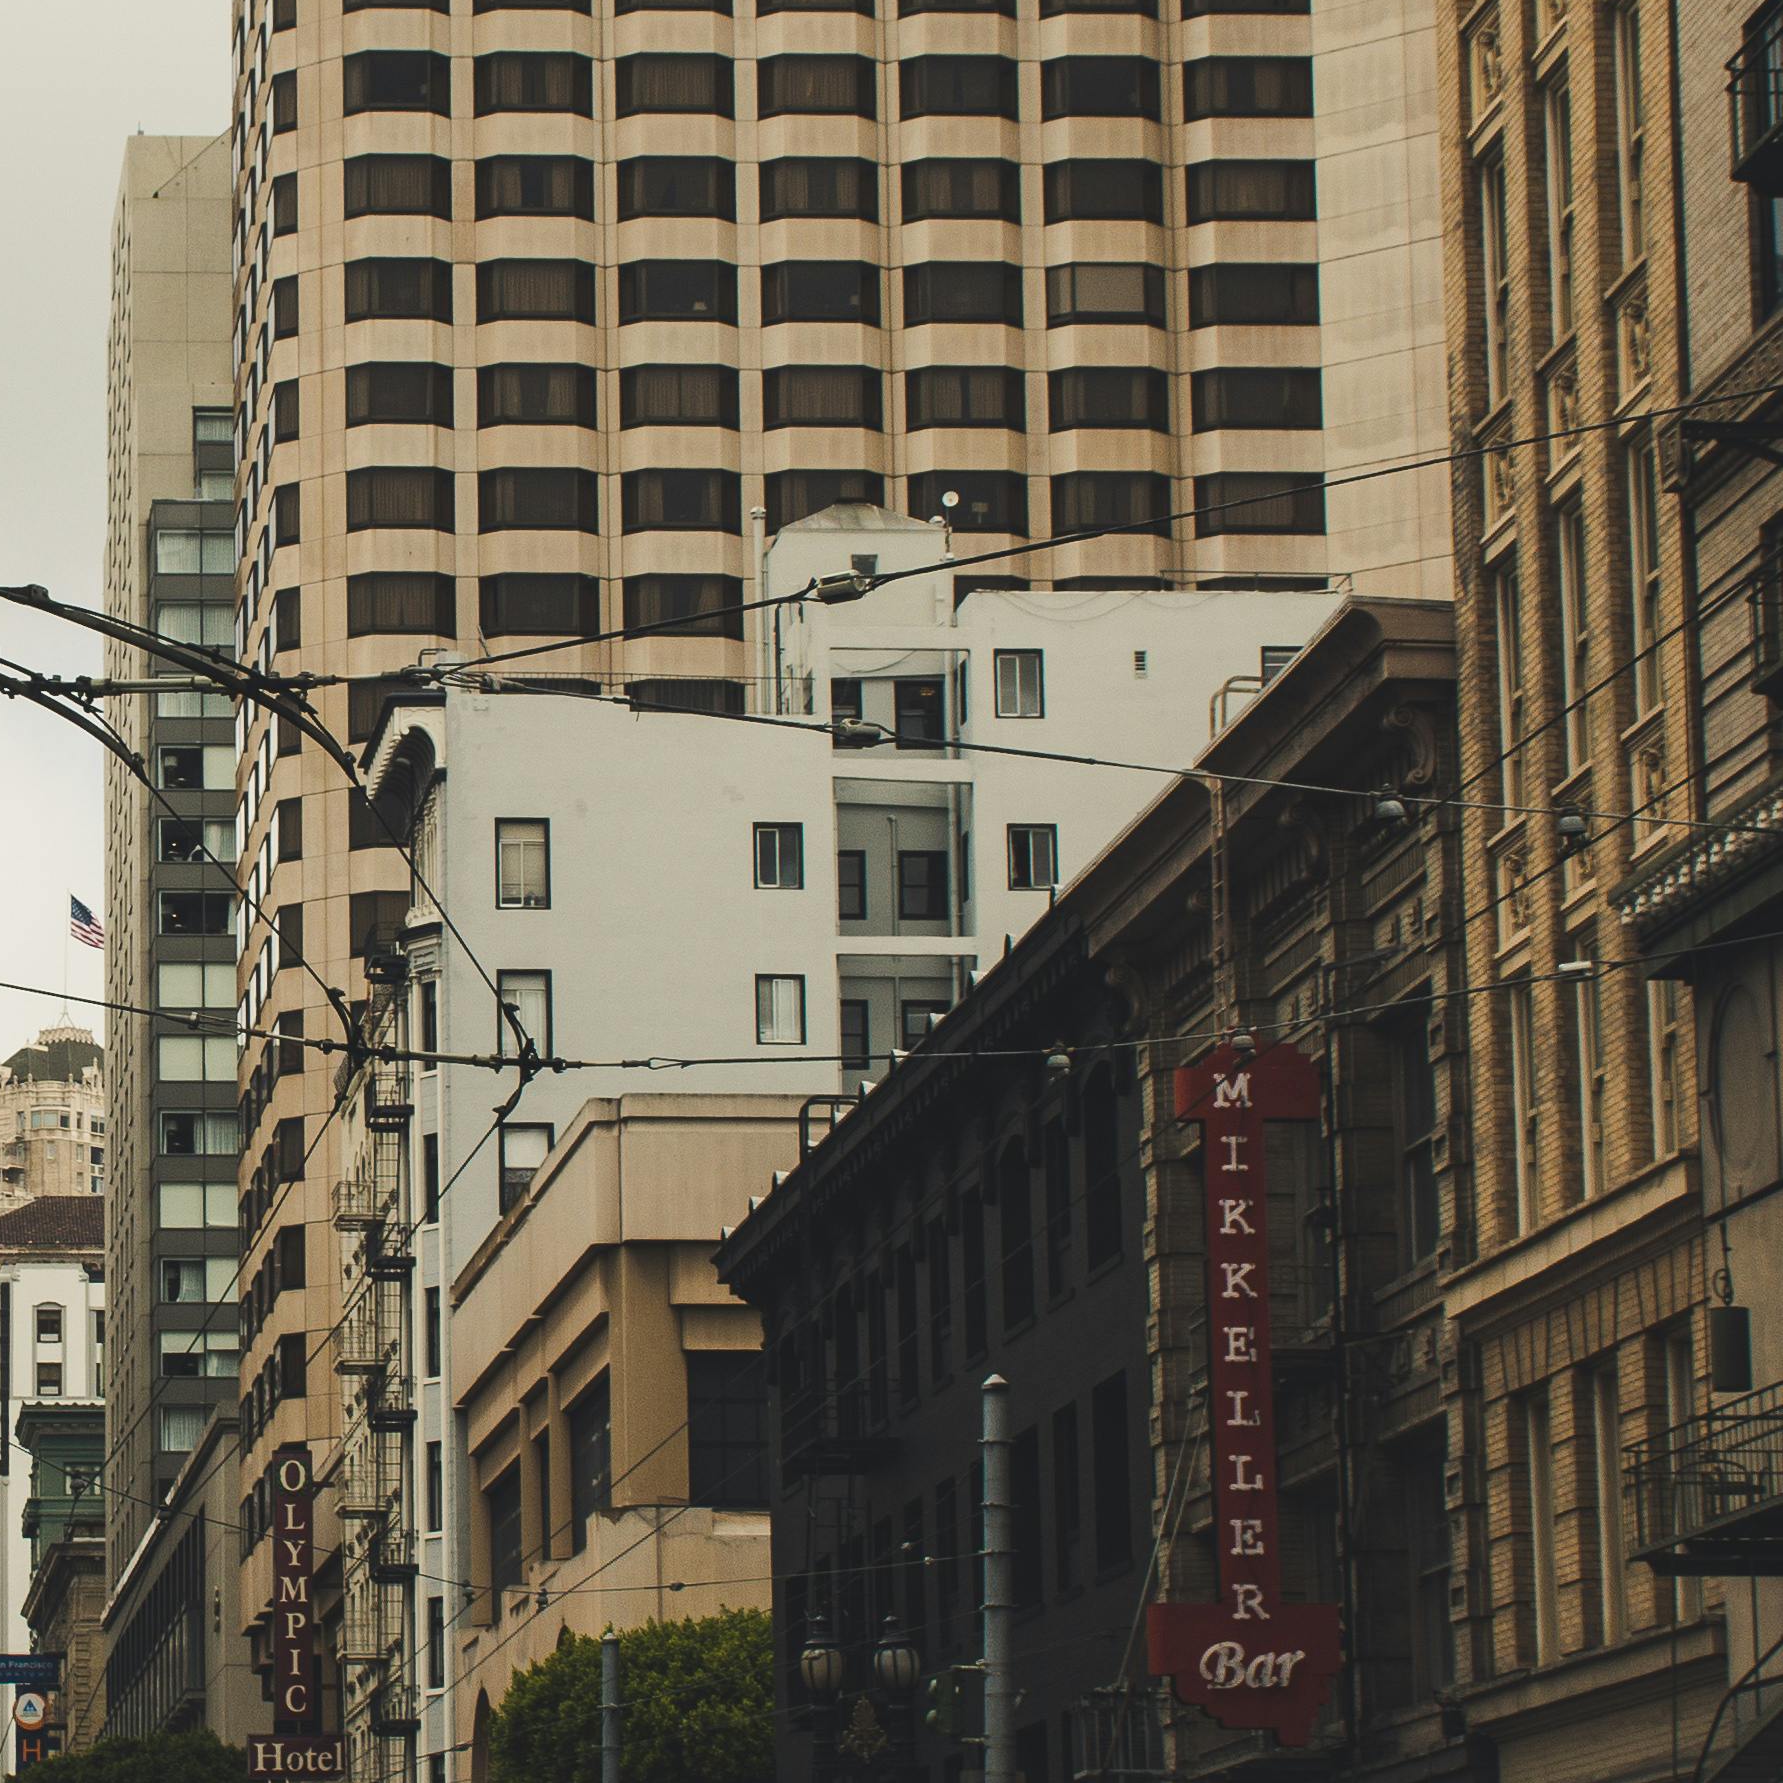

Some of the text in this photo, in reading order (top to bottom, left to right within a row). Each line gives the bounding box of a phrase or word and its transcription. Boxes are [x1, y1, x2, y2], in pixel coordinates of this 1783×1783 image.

[1212, 1072, 1271, 1621] MIKKELLER
[279, 1459, 308, 1714] OLYMPIC
[1198, 1639, 1308, 1691] Bar
[253, 1741, 344, 1772] Hotel
